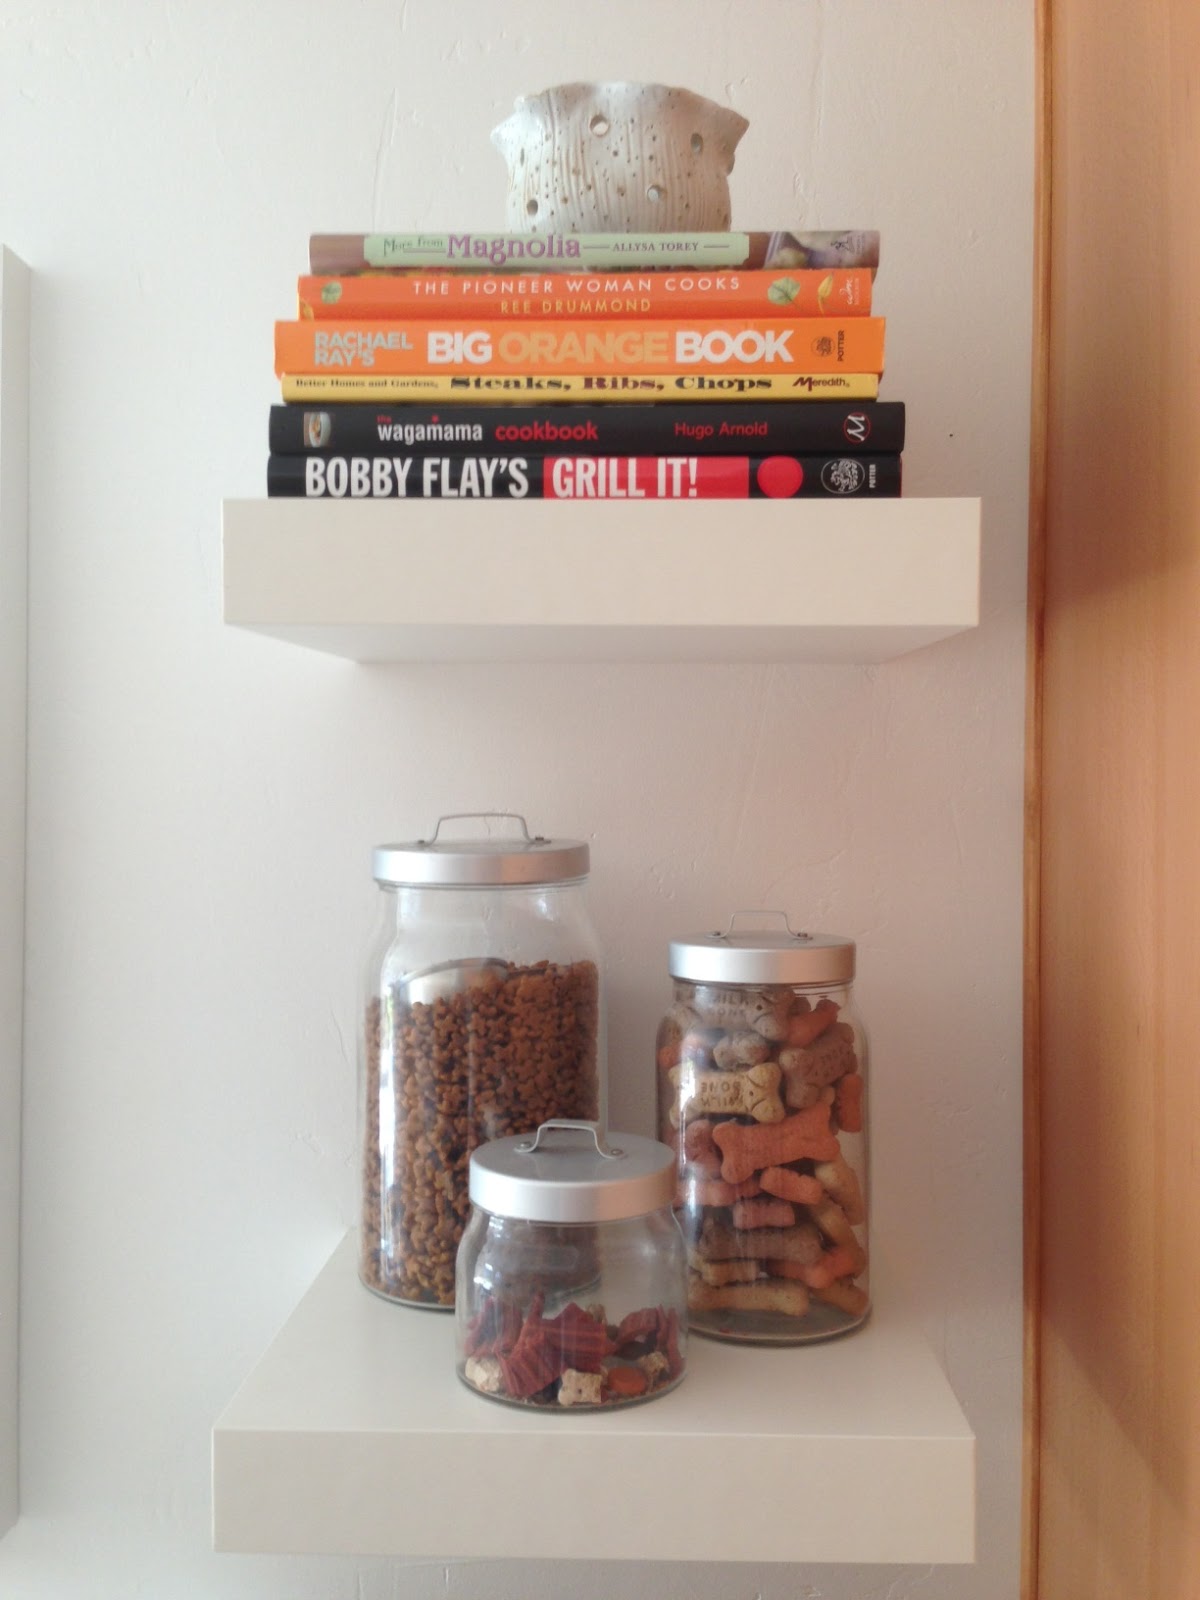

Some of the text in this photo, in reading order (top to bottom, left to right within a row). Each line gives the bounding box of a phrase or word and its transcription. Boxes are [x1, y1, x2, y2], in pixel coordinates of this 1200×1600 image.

[447, 234, 580, 265] Magnolia
[612, 242, 698, 251] ALLYSA TOREY
[414, 277, 739, 294] THE PIONEER WOMAN COOKS
[501, 298, 651, 313] REE DRUMMOND
[314, 331, 413, 350] RACHAEL
[427, 330, 794, 364] BIG ORANGE BOOK
[837, 330, 845, 362] POTTER
[314, 349, 374, 367] RAY'S
[451, 377, 772, 393] Steaks, Ribs, Chops
[377, 421, 768, 445] wagamama cookbook Hugo Arnold
[305, 457, 698, 498] BOBBY FLAY'S GRILL IT!
[869, 464, 877, 488] POTTER
